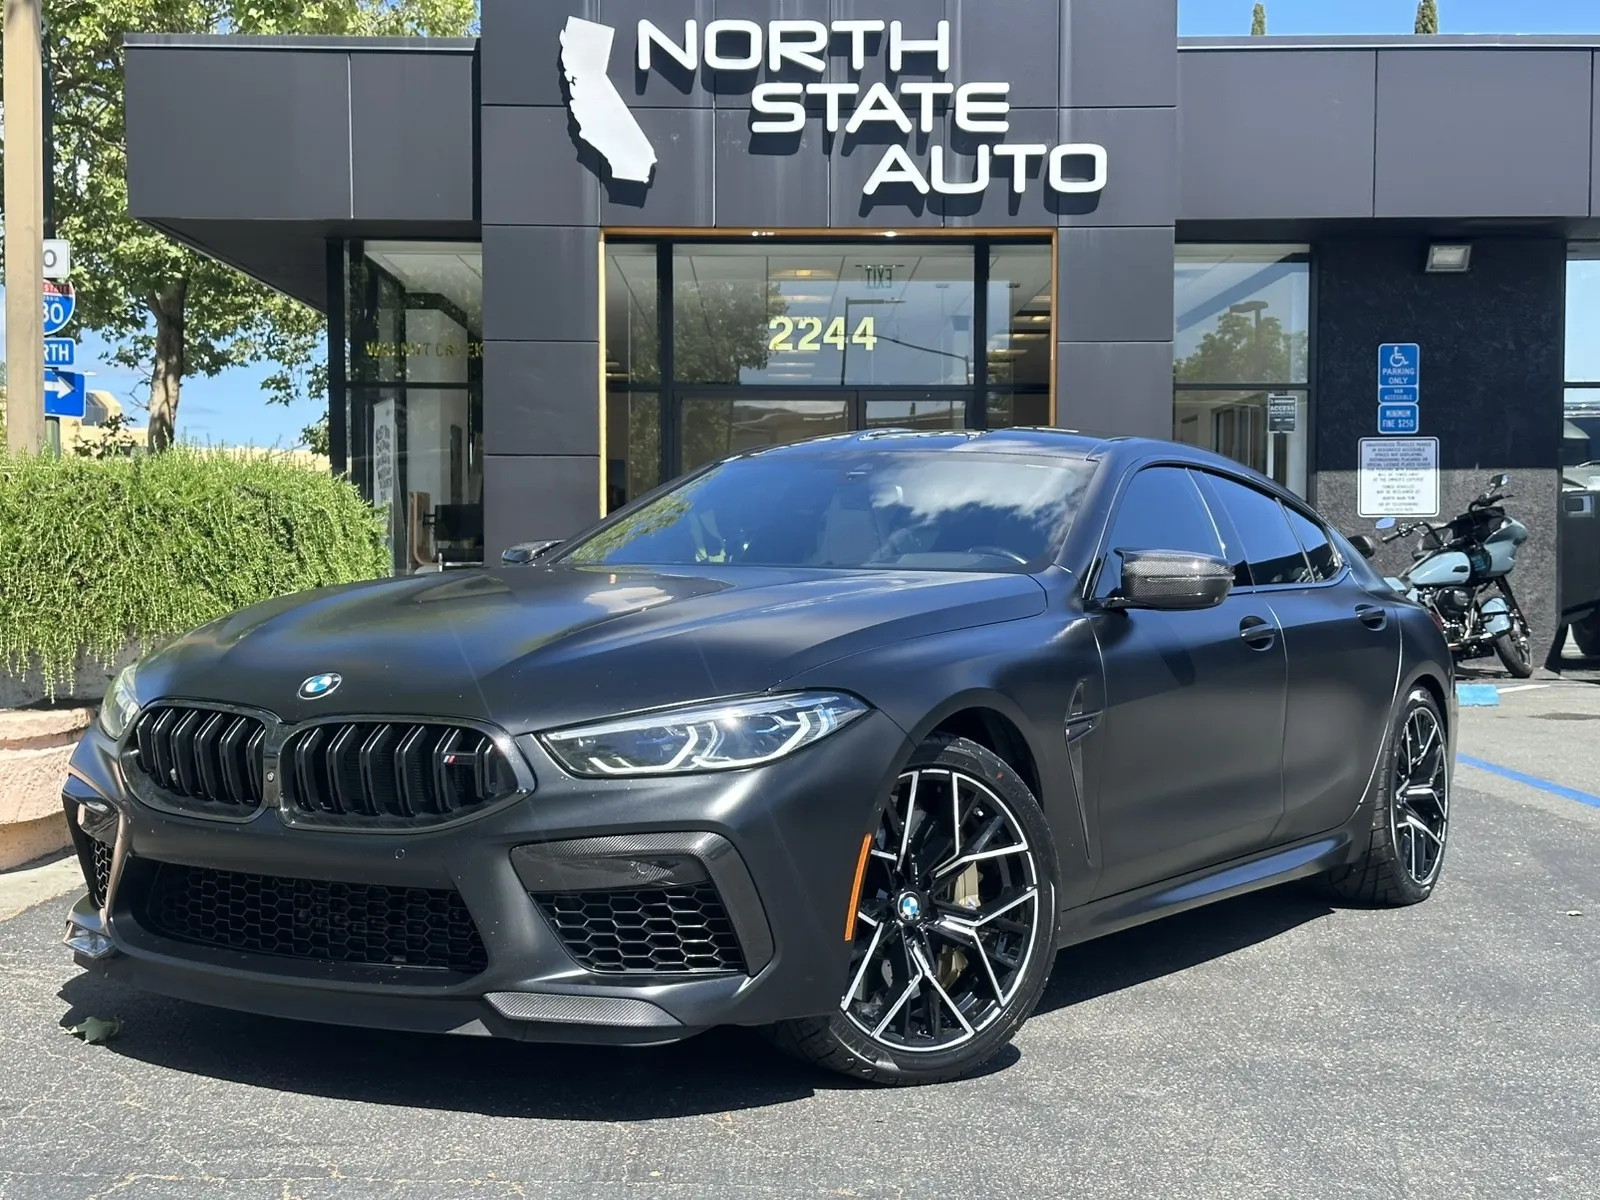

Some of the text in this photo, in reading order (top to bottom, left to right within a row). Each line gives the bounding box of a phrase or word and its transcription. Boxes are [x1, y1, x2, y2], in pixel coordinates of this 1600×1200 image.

[637, 19, 950, 72] NORTH
[751, 82, 1010, 134] STATE
[863, 143, 1108, 195] AUTO
[768, 316, 877, 350] 2244
[43, 344, 69, 361] RTH
[1382, 367, 1415, 376] PARKING
[1388, 377, 1408, 385] ONLY
[1386, 409, 1411, 418] MINIMUM
[1382, 419, 1414, 428] FINE $250
